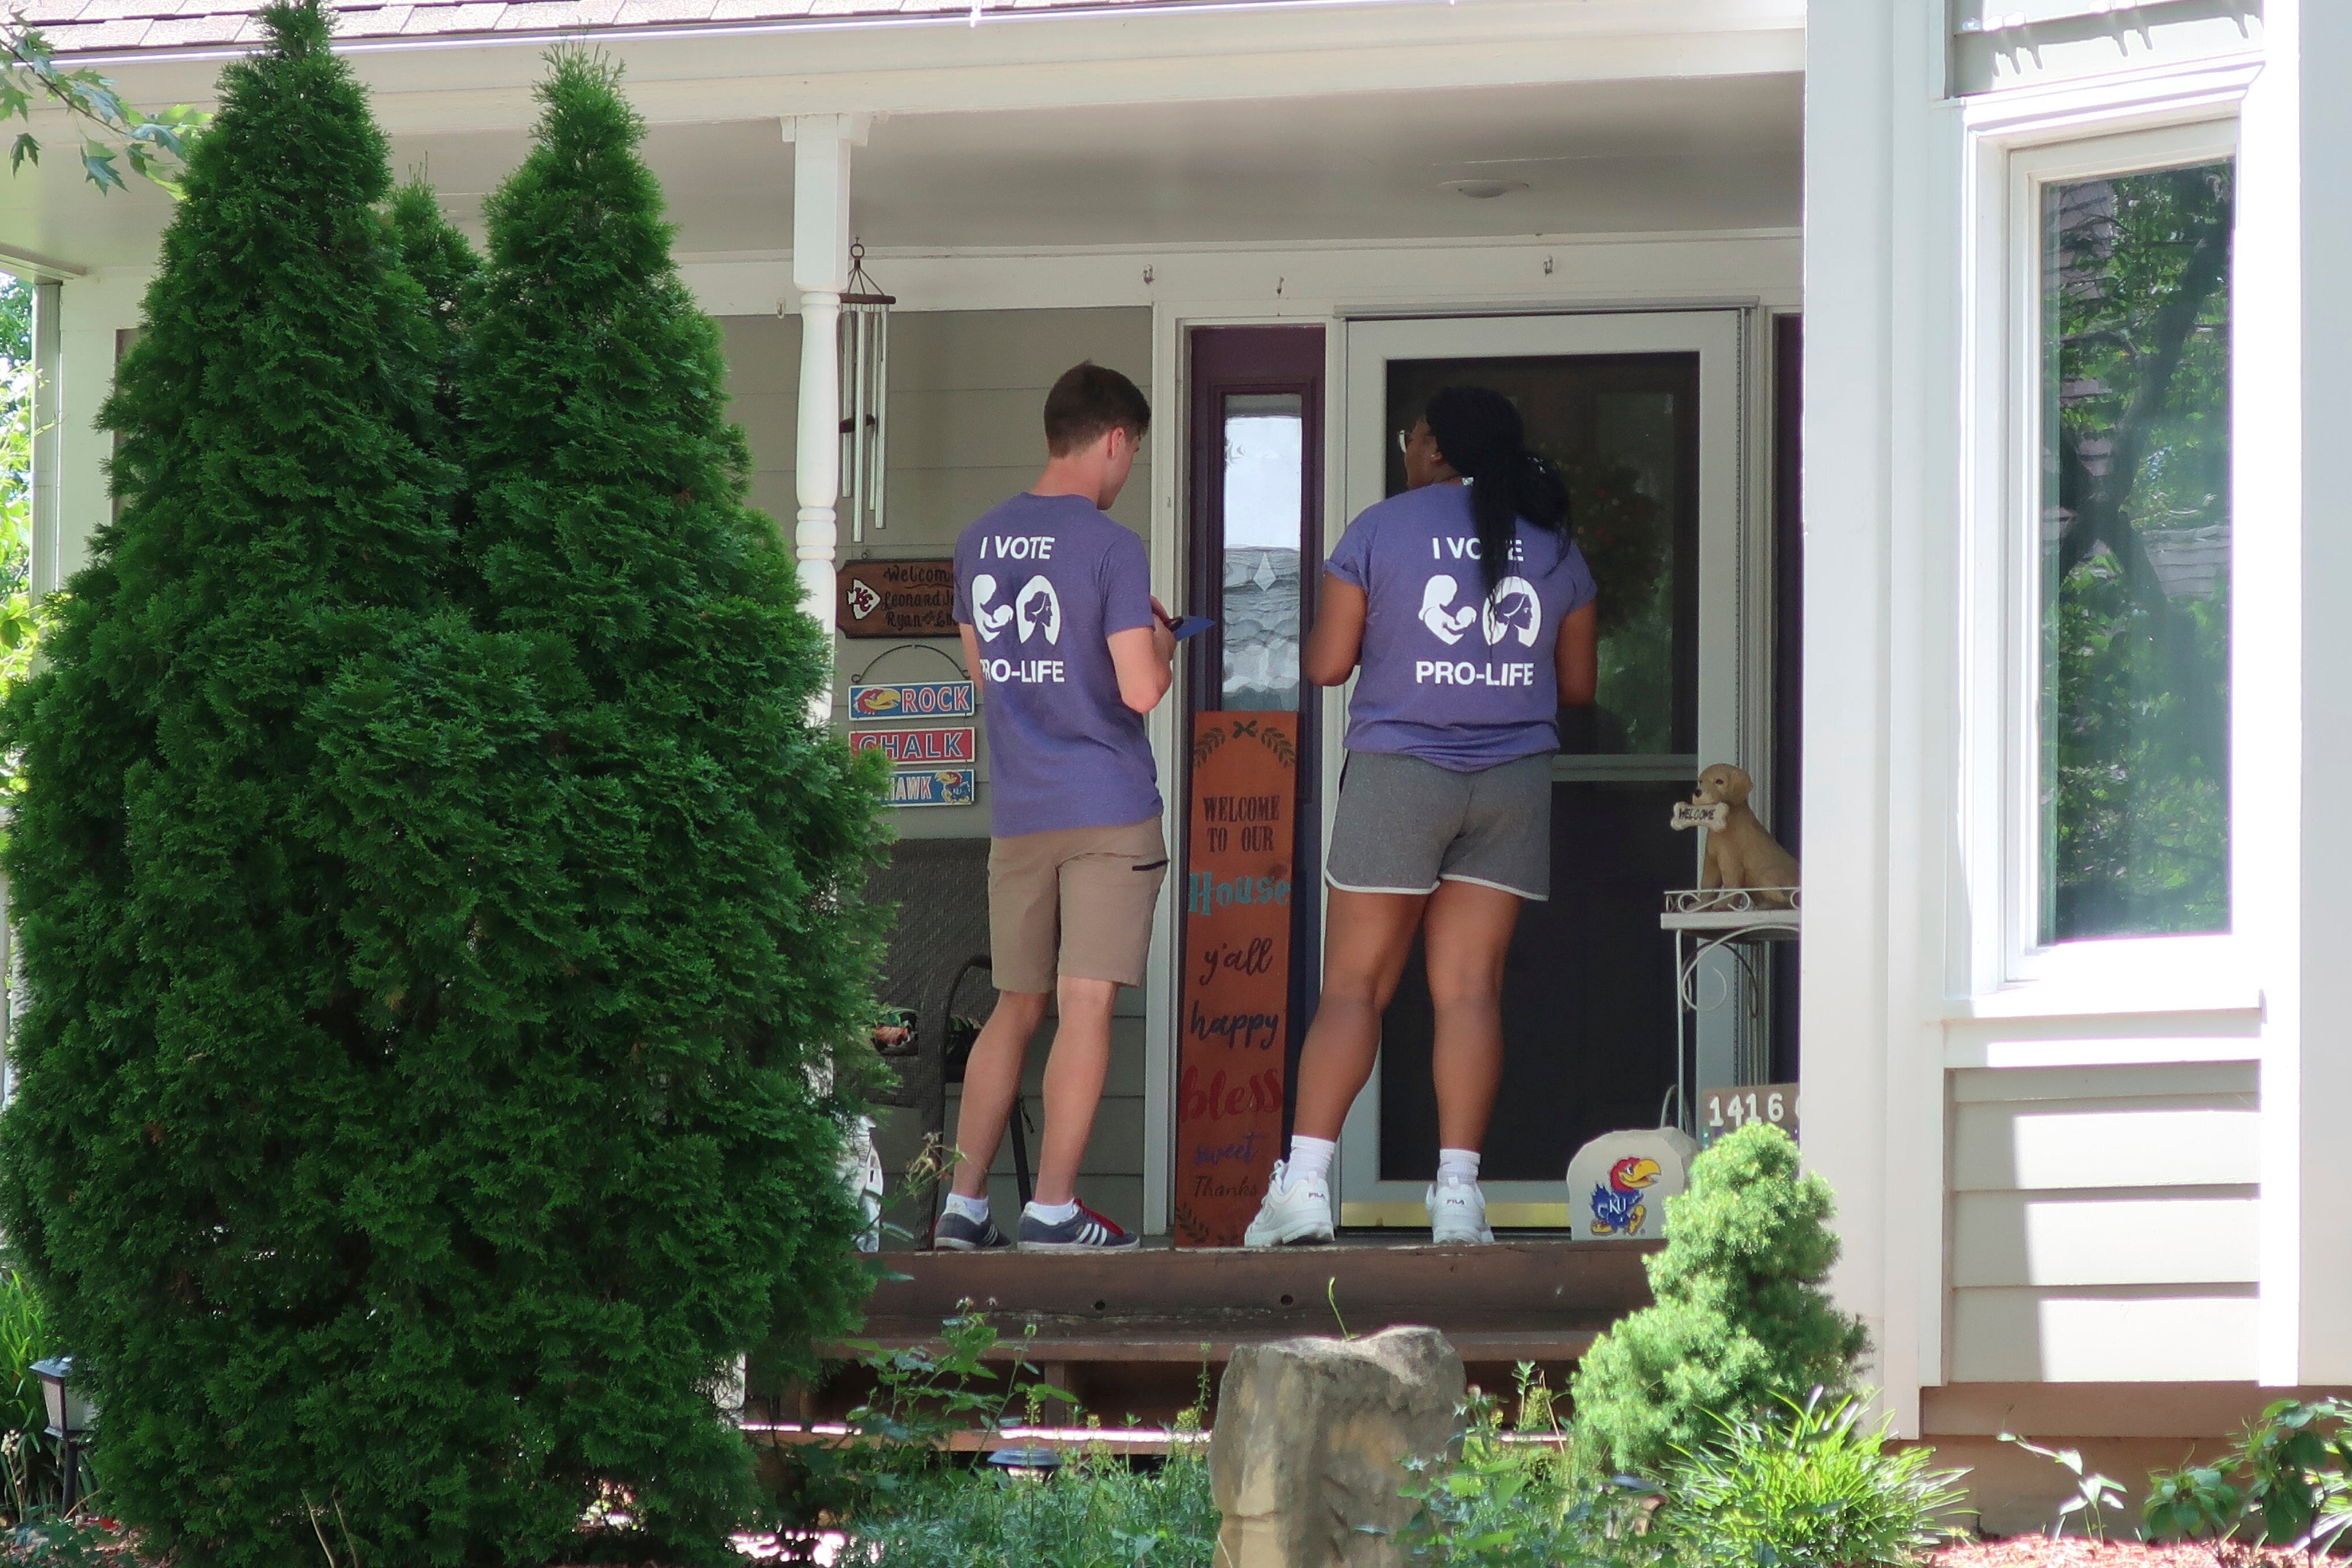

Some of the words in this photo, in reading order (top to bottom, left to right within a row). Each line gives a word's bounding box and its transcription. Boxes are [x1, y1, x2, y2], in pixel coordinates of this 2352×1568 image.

[979, 536, 988, 559] I
[995, 536, 1056, 560] VOTE
[1432, 537, 1440, 559] I
[1446, 537, 1524, 561] VOE
[883, 564, 954, 582] Welcom
[885, 611, 922, 631] Ryan
[1416, 660, 1534, 686] PRO-LIFE
[902, 686, 970, 713] ROCK
[1203, 795, 1280, 822] WELCOME
[1207, 827, 1228, 853] TO
[1241, 826, 1274, 852] OUR
[1187, 871, 1291, 916] House
[1190, 1001, 1278, 1050] happy
[1179, 1066, 1284, 1123] bless
[1709, 1092, 1784, 1127] 1416
[1194, 1175, 1257, 1198] Thanks
[1609, 1198, 1626, 1214] KU
